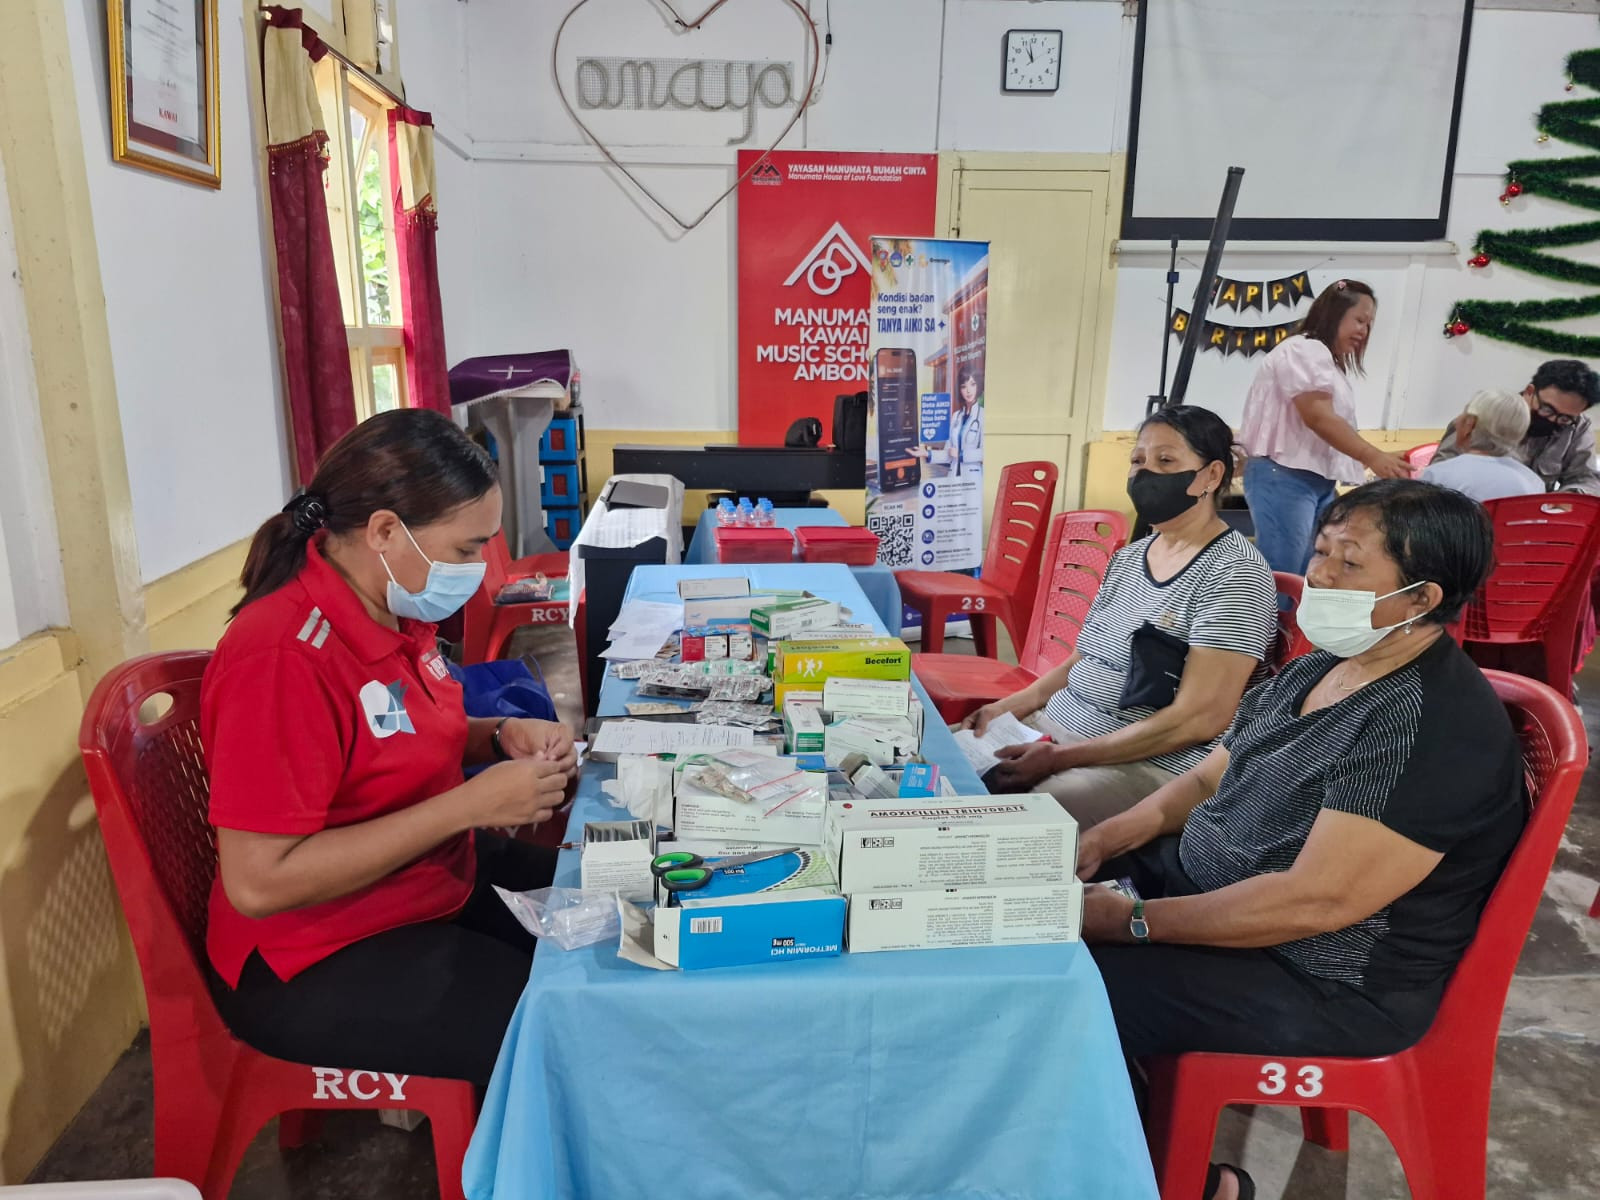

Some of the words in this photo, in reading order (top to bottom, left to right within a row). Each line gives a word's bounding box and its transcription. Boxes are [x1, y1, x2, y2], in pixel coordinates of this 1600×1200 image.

[788, 164, 824, 173] YAYASAN
[826, 165, 871, 174] MANUMATA
[873, 166, 901, 174] RUMAH
[903, 166, 926, 175] CINTA
[866, 174, 902, 182] Foundation
[1212, 274, 1306, 302] APPY
[877, 292, 908, 303] Kondisi
[909, 293, 935, 303] badan
[774, 307, 870, 326] MANUMA
[877, 305, 897, 316] seng
[898, 303, 922, 314] enak?
[877, 317, 902, 333] TANYA
[904, 317, 923, 333] AIKO
[924, 317, 936, 333] SA
[800, 326, 868, 345] KAWAI
[756, 345, 821, 363] MUSIC
[793, 363, 870, 381] AMBON
[961, 596, 985, 611] 23
[531, 606, 570, 622] RCY
[865, 656, 902, 665] Becefort
[870, 809, 951, 818] AMOXICILLIN
[955, 804, 1029, 815] TRIHYDRATE
[772, 938, 783, 946] mg
[786, 943, 838, 954] METFORMIN
[311, 1066, 410, 1101] RCY
[1257, 1061, 1324, 1098] 33
